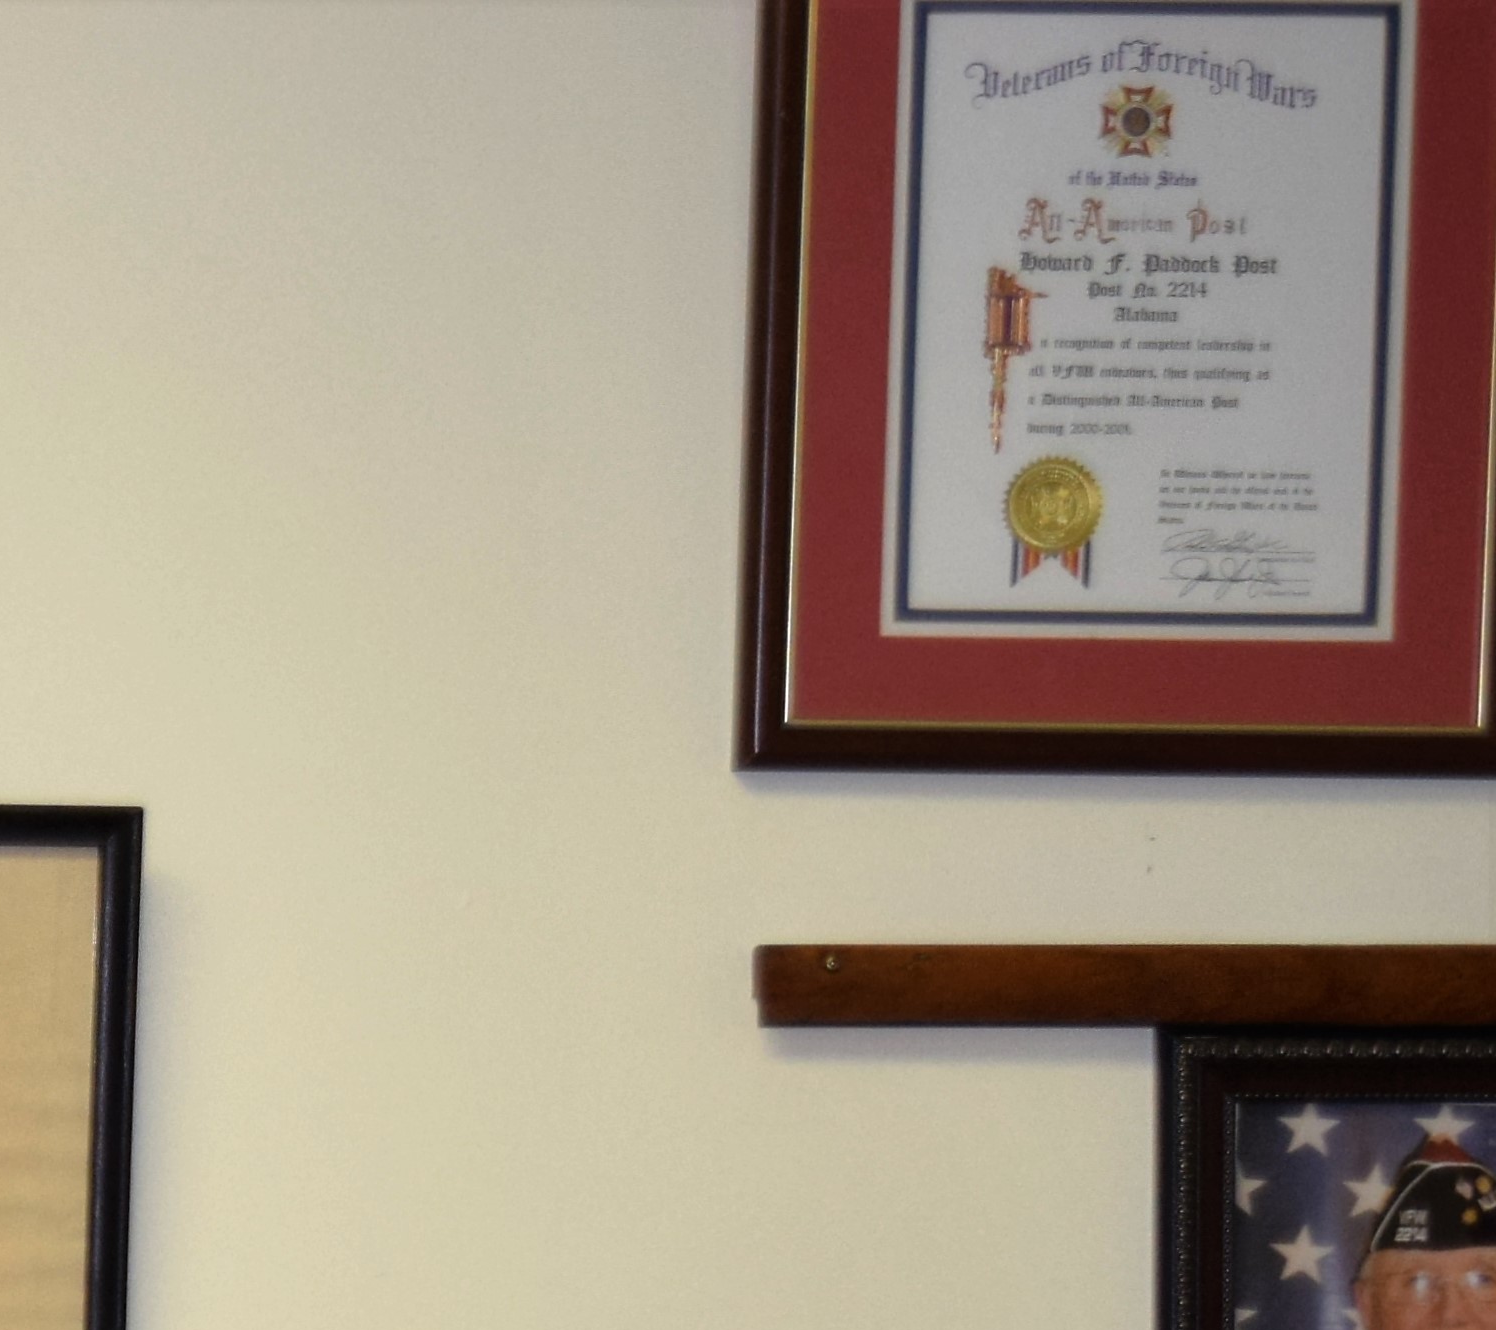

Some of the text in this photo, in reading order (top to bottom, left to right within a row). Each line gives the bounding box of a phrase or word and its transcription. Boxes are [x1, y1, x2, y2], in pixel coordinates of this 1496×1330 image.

[965, 40, 1318, 109] Veterans of Foreign Wars
[1068, 169, 1198, 189] of the United States
[1186, 199, 1248, 242] Post
[1020, 252, 1277, 277] Howard F. Paddock Post
[1088, 282, 1121, 299] Post
[1166, 282, 1208, 299] 2214
[1114, 306, 1179, 322] Alabama
[1054, 338, 1113, 351] recognition
[1120, 337, 1132, 350] of
[1137, 338, 1194, 352] competent
[1211, 395, 1239, 410] Post
